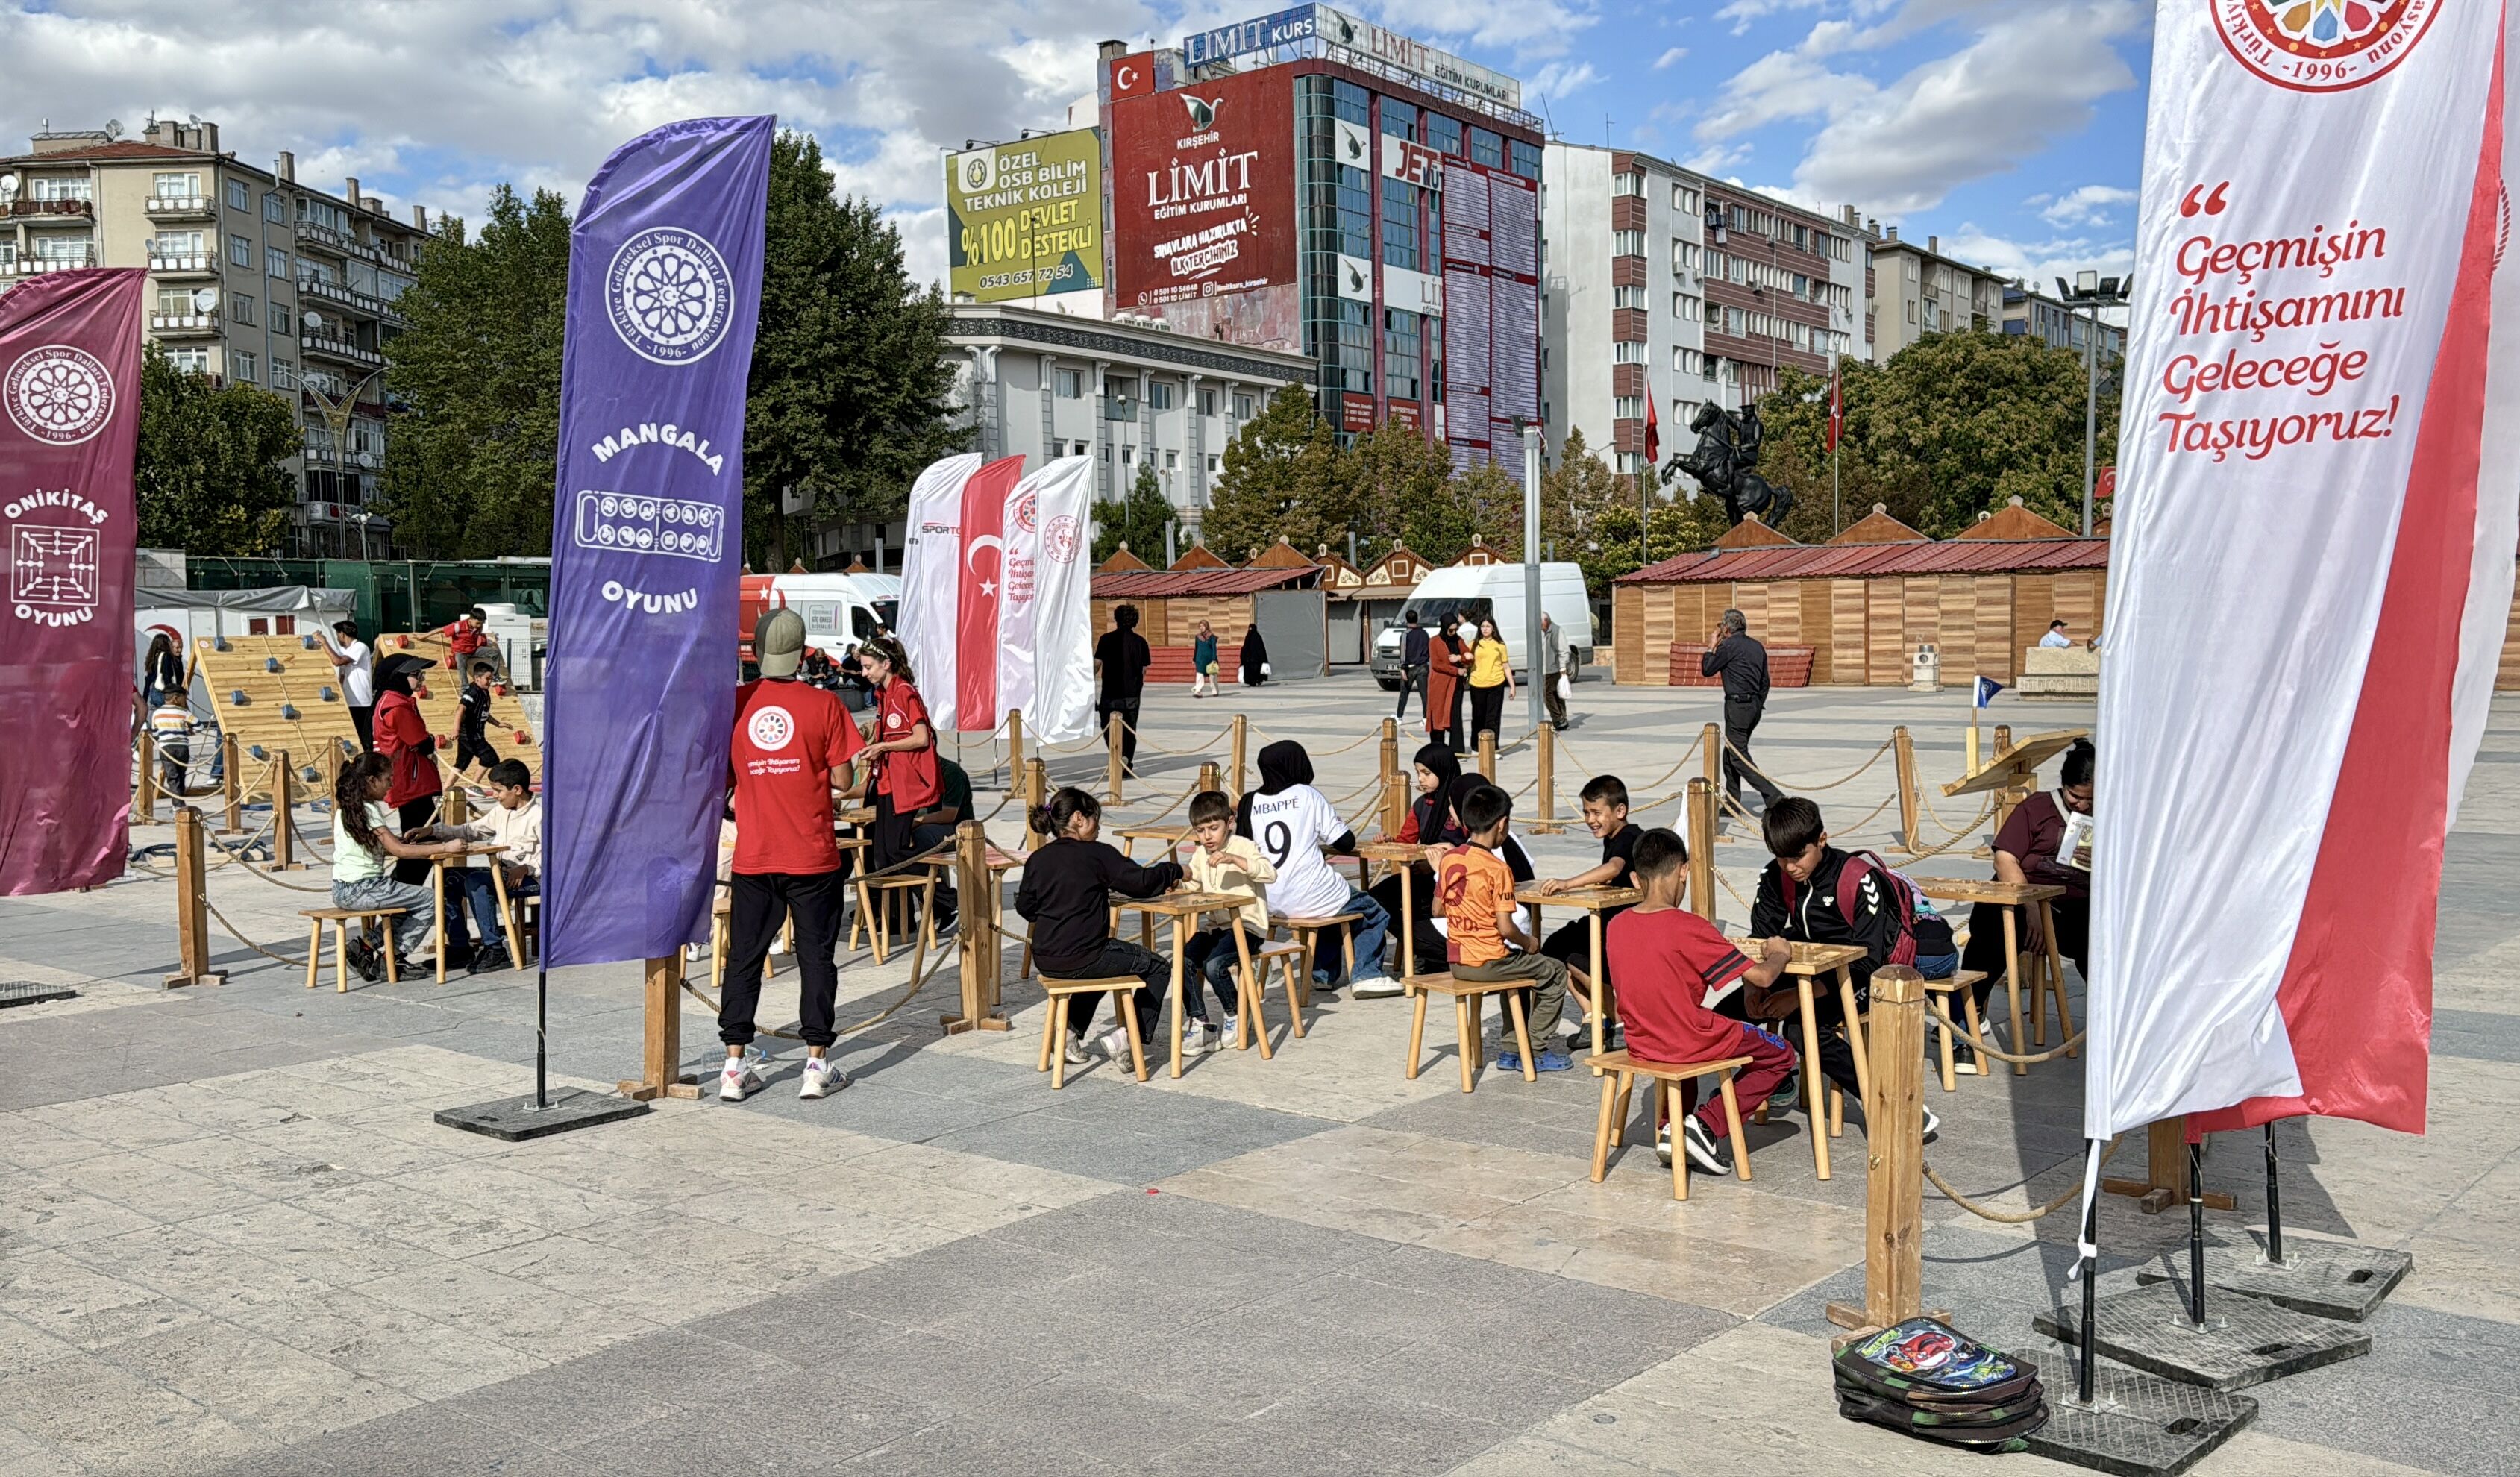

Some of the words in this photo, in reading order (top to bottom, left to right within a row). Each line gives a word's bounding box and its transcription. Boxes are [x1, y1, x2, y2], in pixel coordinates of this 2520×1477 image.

[1272, 18, 1313, 43] KURS
[2226, 0, 2275, 67] Türkiy
[2366, 0, 2425, 64] asyonu
[1464, 75, 1510, 102] KURUMLARI
[1176, 130, 1220, 150] KIRŞEHİR
[998, 151, 1041, 172] ÖZEL
[999, 169, 1033, 189] OSB
[1038, 160, 1087, 182] BİLİM
[1147, 148, 1258, 207] LİMİT
[1396, 140, 1438, 184] JET
[964, 188, 1024, 212] TEKNİK
[1029, 177, 1087, 201] KOLEJİ
[1154, 203, 1187, 220] EĞİTİM
[1190, 192, 1247, 213] KURUMLARI
[1020, 198, 1079, 231] DEVLET
[653, 233, 684, 247] Spor
[961, 217, 1016, 268] %100
[1021, 219, 1092, 260] DESTEKLİ
[2175, 219, 2386, 286] Geçmişin
[610, 236, 652, 292] Geleneksel
[980, 274, 1010, 289] 0543
[1013, 271, 1035, 285] 657
[1038, 267, 1053, 281] 72
[1056, 263, 1073, 278] 54
[1159, 287, 1170, 295] 501
[1159, 295, 1170, 304] 501
[613, 297, 641, 346] Türkiye
[691, 277, 728, 351] Federasyonu
[2169, 286, 2406, 343] İhtişamını
[45, 349, 72, 359] Spor
[8, 351, 44, 395] Geleneksel
[2163, 340, 2369, 404] Geleceğe
[11, 397, 37, 432] Türkiye
[2158, 394, 2400, 463] Taşıyoruz!
[591, 422, 724, 477] MANGALA
[4, 488, 109, 525] ONİKİTAŞ
[601, 580, 698, 614] OYUNU
[14, 603, 93, 627] OYUNU
[1253, 796, 1300, 815] MBAPPÉ
[1264, 820, 1291, 870] 9
